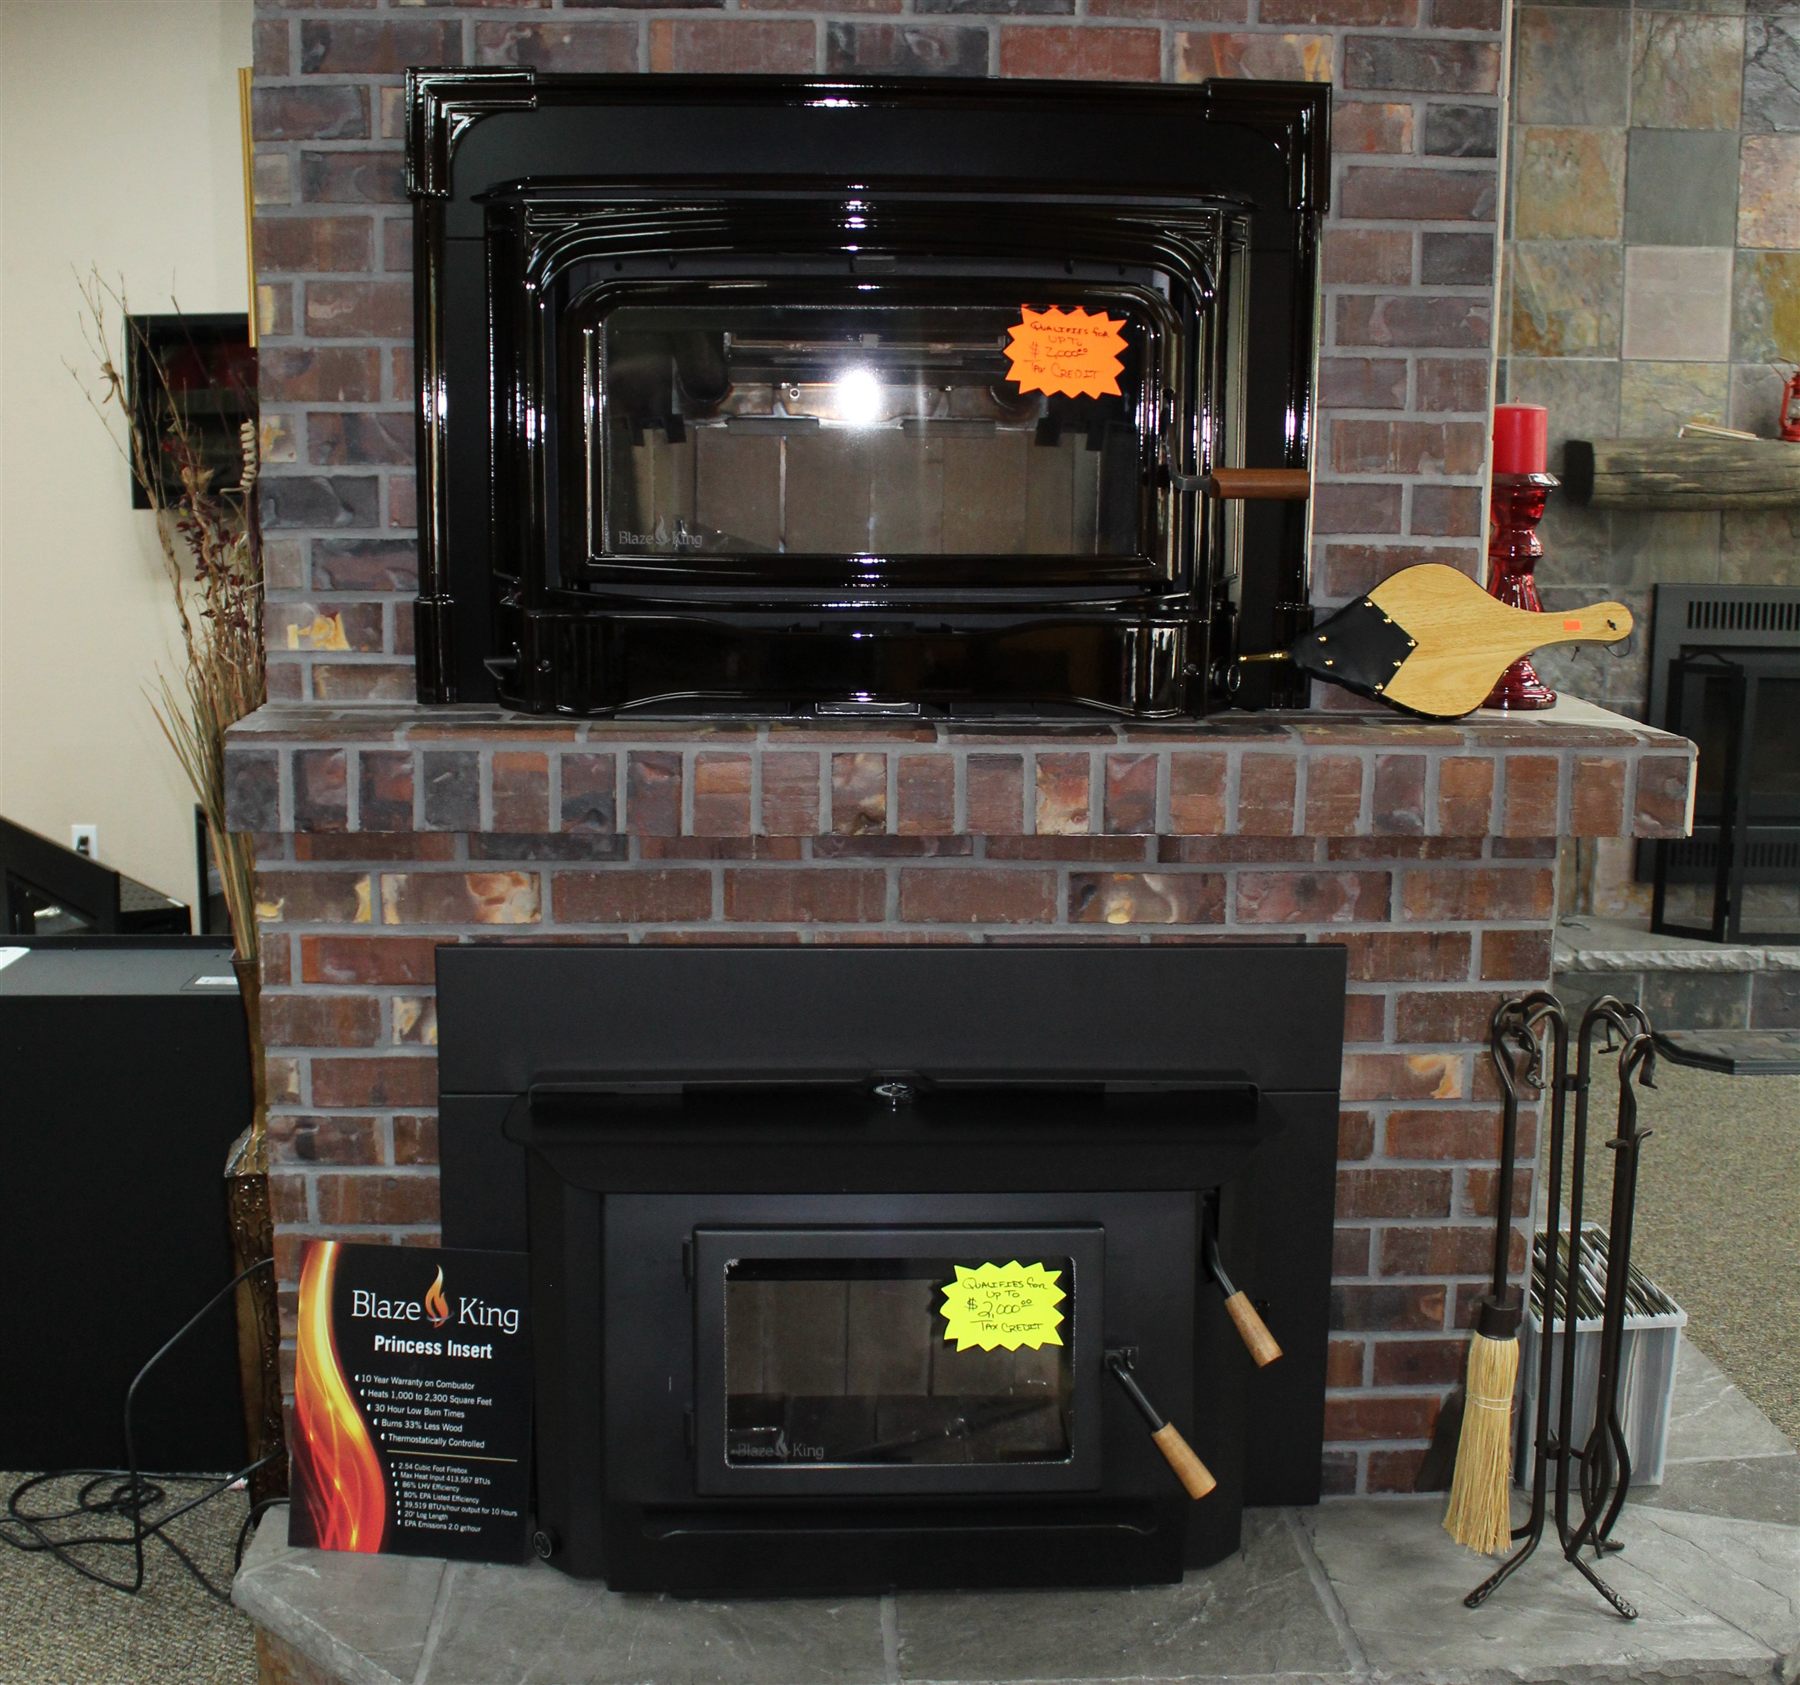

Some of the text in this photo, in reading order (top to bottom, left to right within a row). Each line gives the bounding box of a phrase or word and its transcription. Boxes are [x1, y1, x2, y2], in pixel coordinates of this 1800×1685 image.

[619, 531, 702, 548] Blaze King
[962, 1277, 1024, 1290] QUALIFIES
[351, 1290, 519, 1335] Blaze King
[970, 1320, 1044, 1333] TAX CREDIT
[374, 1335, 492, 1359] Princess Insert
[361, 1374, 372, 1383] 10
[373, 1375, 389, 1384] Year
[391, 1376, 423, 1388] Warranty
[436, 1380, 475, 1390] Combustor
[368, 1389, 389, 1398] Heats
[391, 1391, 413, 1400] 1,000
[425, 1393, 448, 1403] 2,300
[449, 1395, 475, 1405] Square
[477, 1397, 492, 1406] Feet
[375, 1404, 465, 1418] 30 Hour Low Burn Times
[381, 1419, 463, 1432] Burns 33% Less Wood
[388, 1433, 485, 1448] Thermostatically Controlled
[737, 1443, 824, 1460] Blaze King
[398, 1462, 413, 1470] 2.54
[414, 1463, 431, 1471] Cubic
[447, 1465, 468, 1474] Firebox
[414, 1472, 428, 1480] Heat
[430, 1474, 445, 1482] Input
[432, 1483, 460, 1493] Efficiency
[420, 1492, 431, 1500] EPA
[433, 1493, 450, 1501] Listed
[451, 1494, 480, 1504] Efficiency
[416, 1512, 427, 1520] Log
[428, 1513, 449, 1521] Length
[461, 1506, 480, 1514] output
[481, 1506, 489, 1514] for
[491, 1507, 500, 1516] 10
[501, 1508, 518, 1517] hours
[418, 1521, 447, 1530] Emissions
[448, 1523, 459, 1531] 2.0
